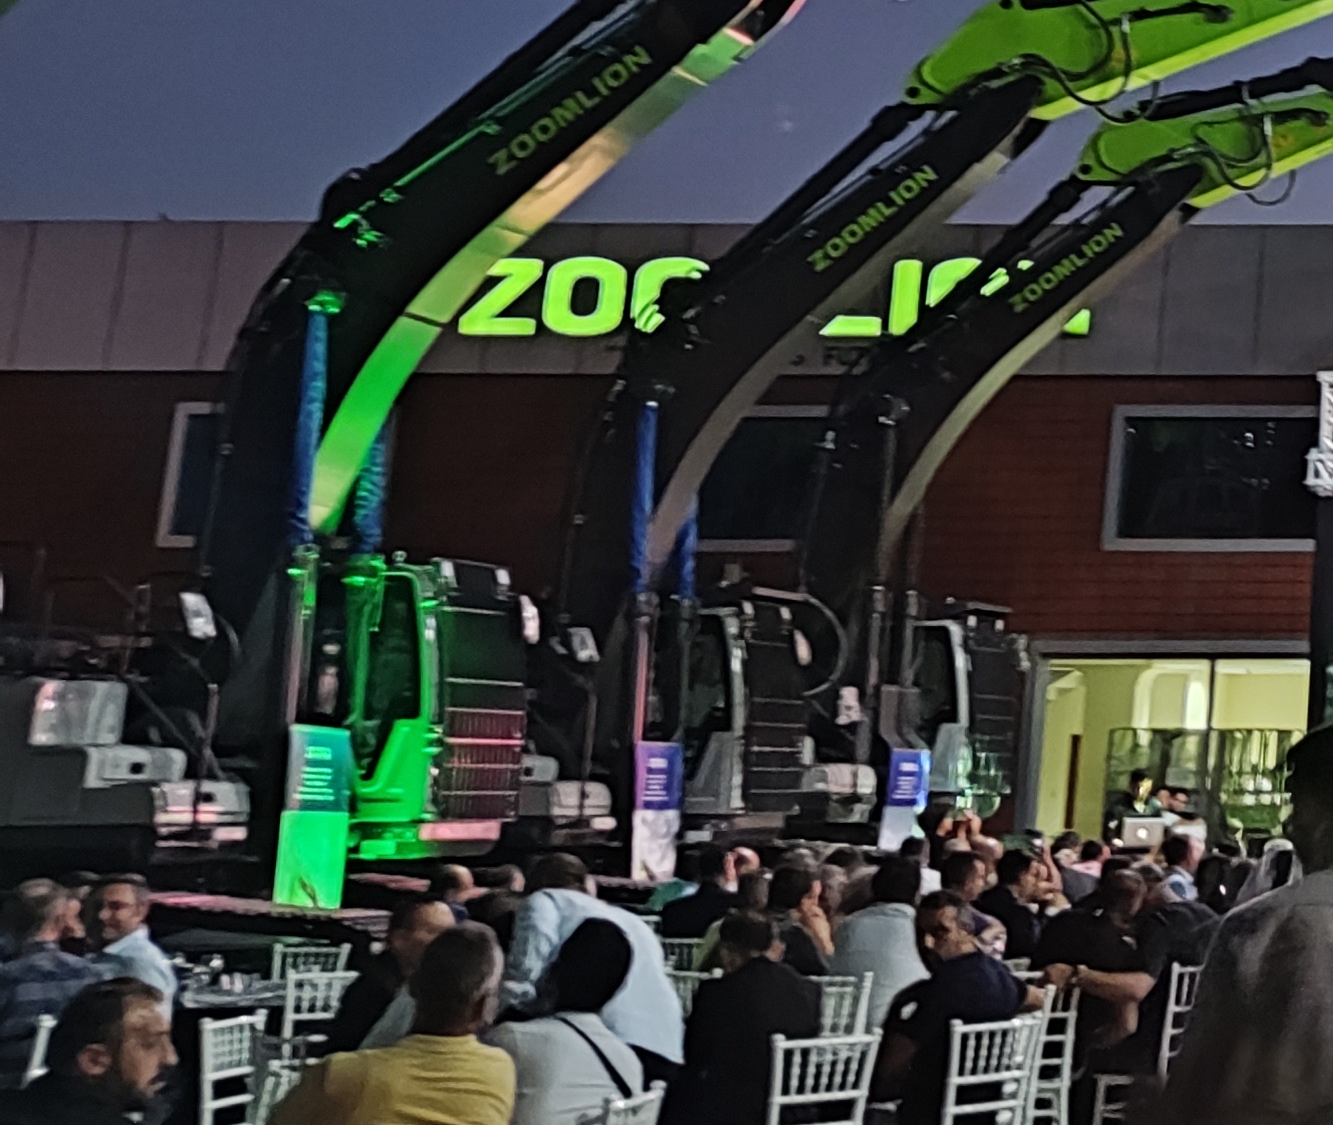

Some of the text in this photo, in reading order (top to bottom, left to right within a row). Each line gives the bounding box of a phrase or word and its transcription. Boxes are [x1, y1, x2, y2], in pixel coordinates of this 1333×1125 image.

[487, 44, 653, 175] ZOOMLION
[806, 164, 939, 273] ZOOMLION
[1008, 222, 1124, 313] ZOOMLION
